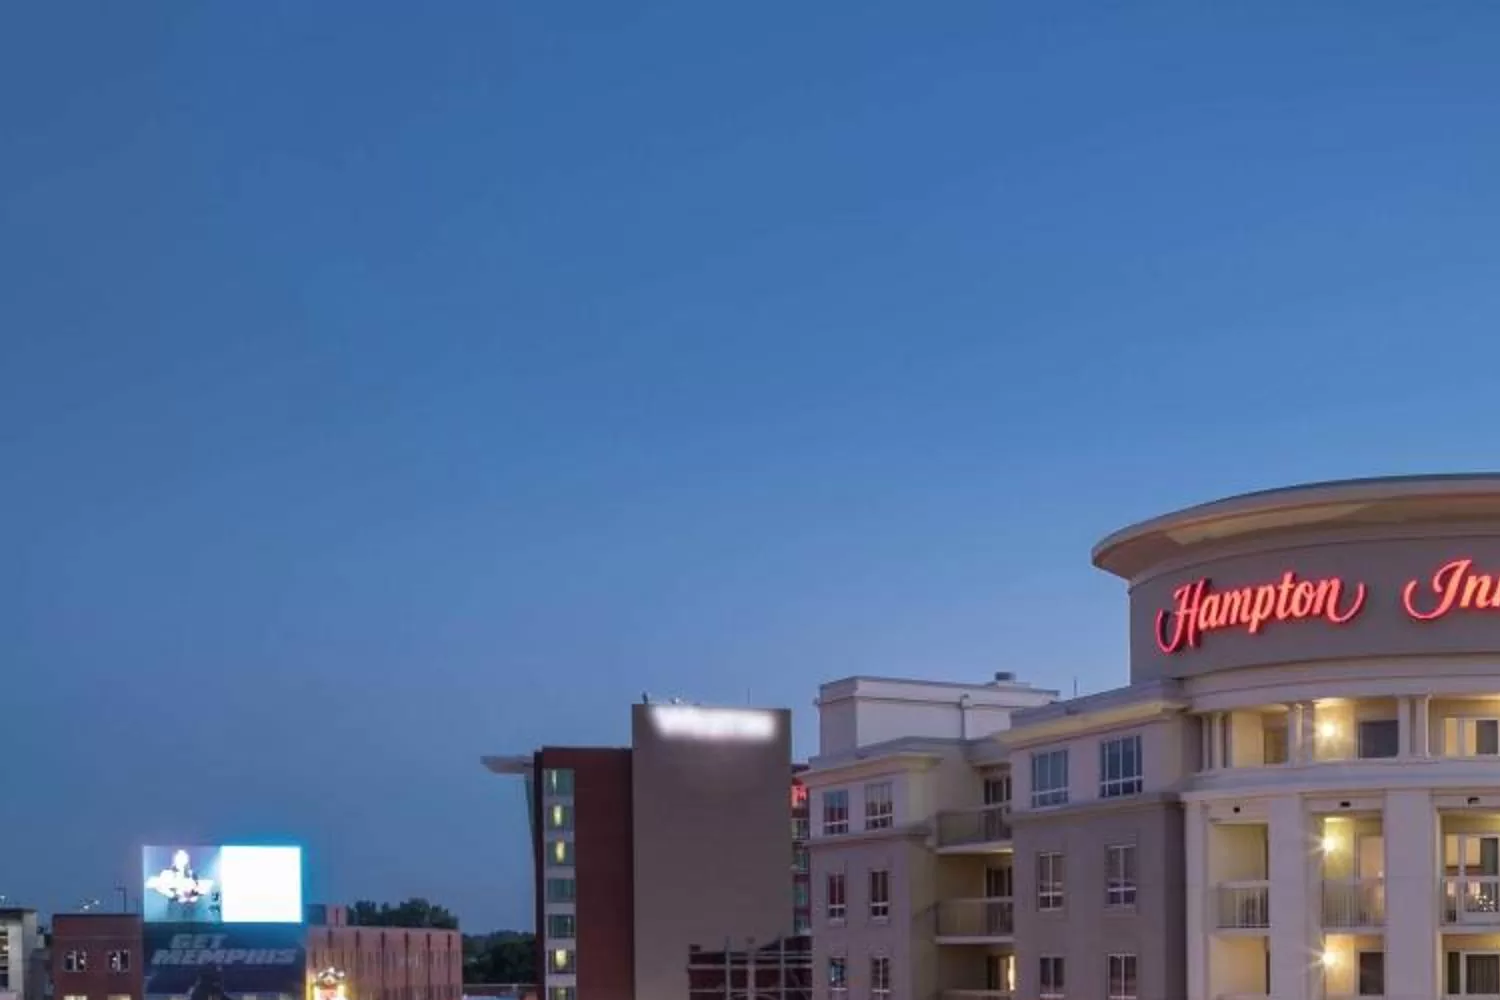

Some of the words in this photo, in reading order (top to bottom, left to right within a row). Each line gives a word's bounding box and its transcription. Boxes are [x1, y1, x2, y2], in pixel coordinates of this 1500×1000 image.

[1155, 568, 1366, 653] Hampton
[170, 933, 227, 950] GET
[151, 949, 297, 965] MEMPHIS
